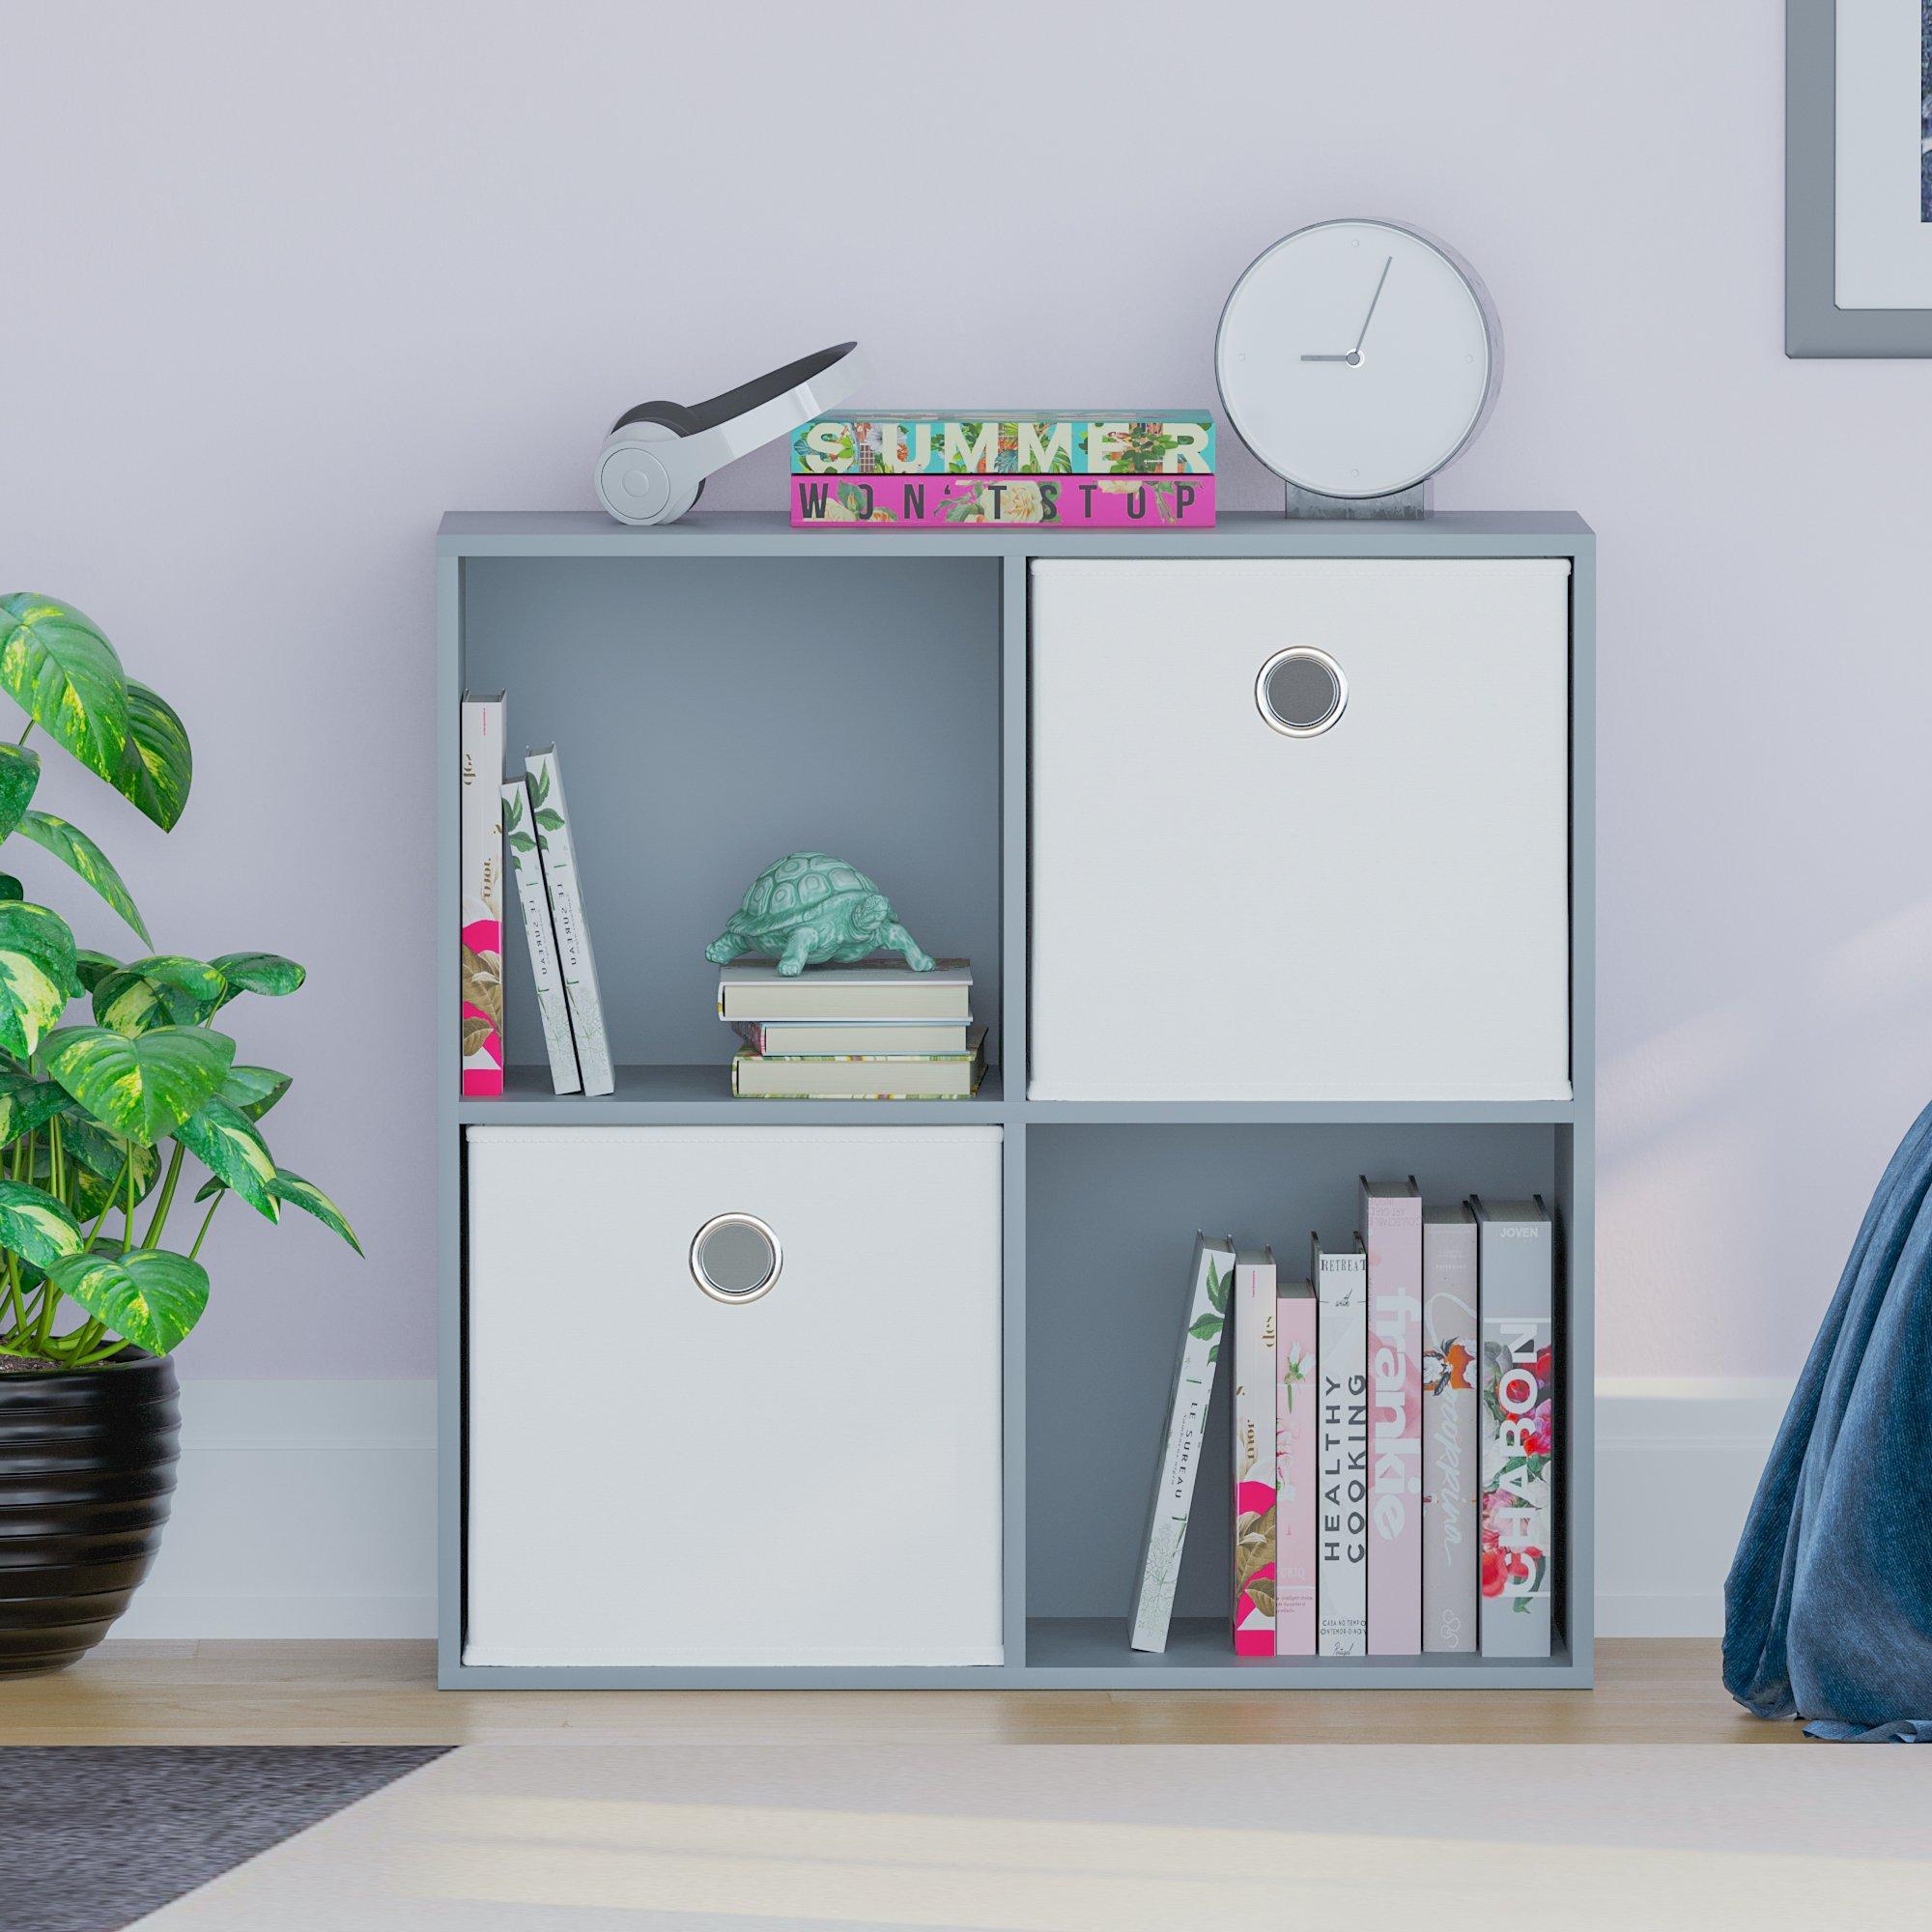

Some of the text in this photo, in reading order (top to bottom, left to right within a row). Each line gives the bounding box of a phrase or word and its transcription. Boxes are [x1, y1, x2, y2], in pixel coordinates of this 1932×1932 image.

[806, 422, 1212, 474] SUMMER
[1040, 483, 1196, 520] STOP
[1321, 1259, 1366, 1272] RETREAT
[1498, 1227, 1539, 1238] JOVEN
[1335, 1289, 1353, 1307] with
[1174, 1402, 1199, 1500] LE SUREAU
[1373, 1287, 1422, 1542] frankie
[1324, 1375, 1341, 1562] HEALTHY
[1348, 1374, 1366, 1564] COOKING
[1497, 1322, 1539, 1595] CHABON
